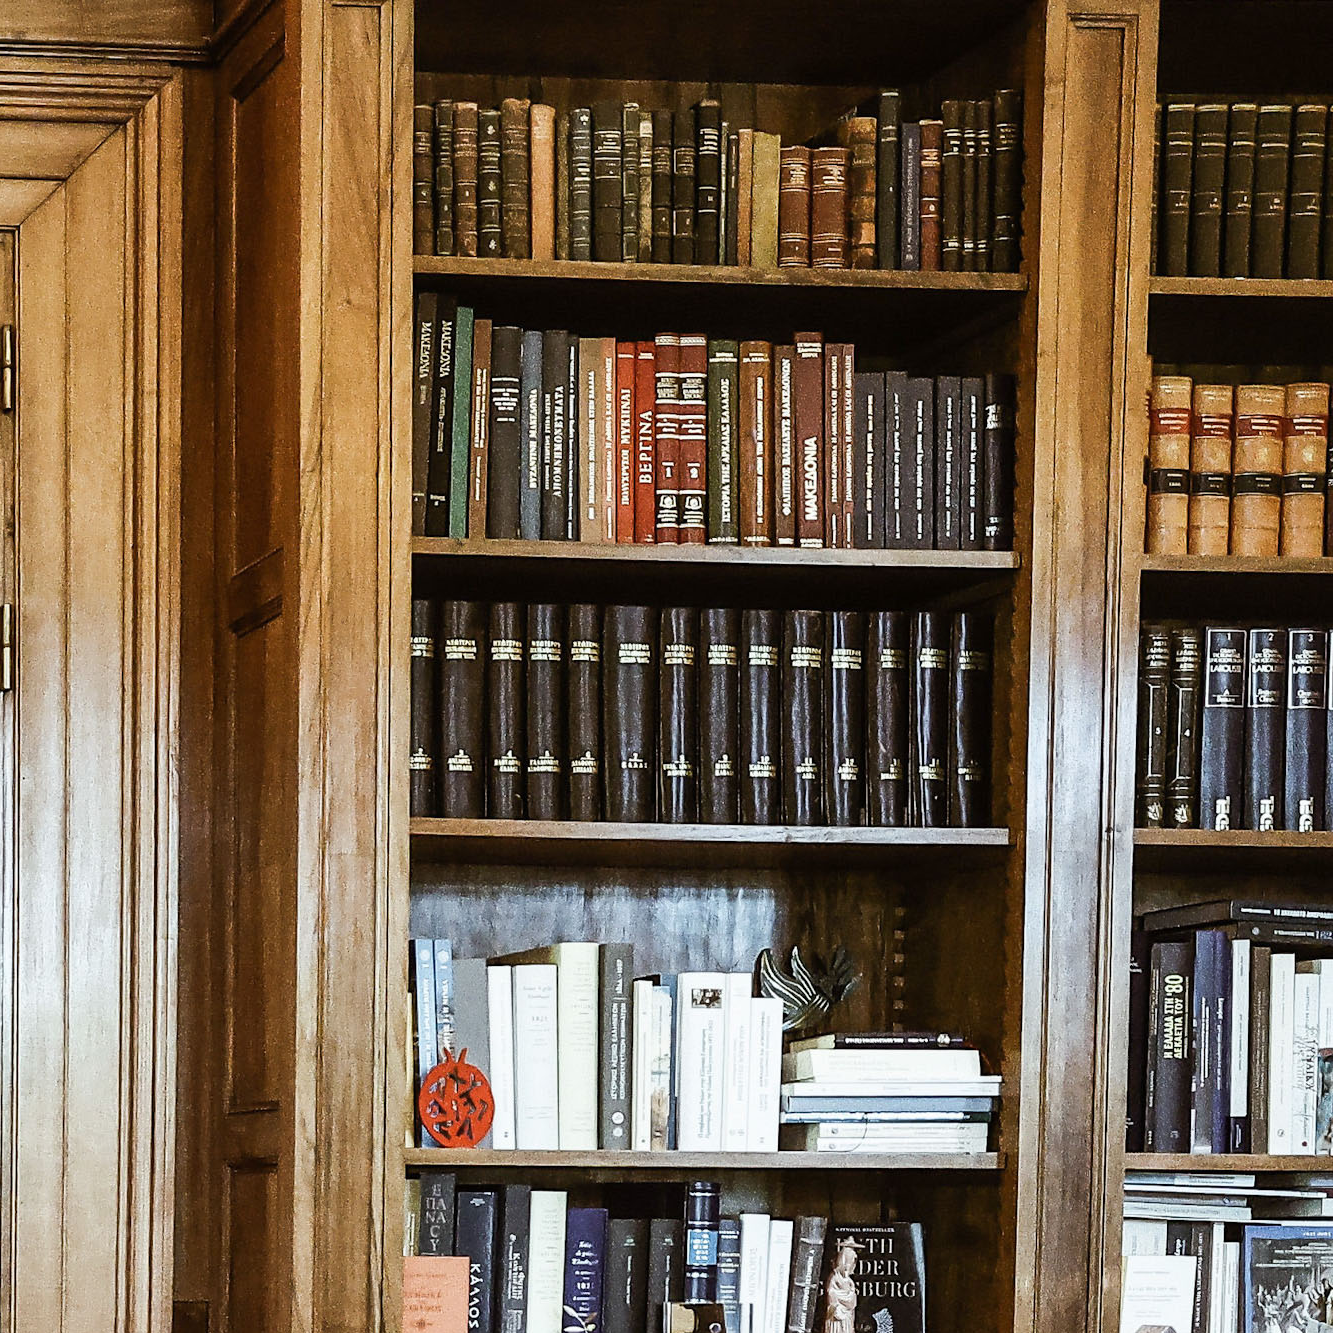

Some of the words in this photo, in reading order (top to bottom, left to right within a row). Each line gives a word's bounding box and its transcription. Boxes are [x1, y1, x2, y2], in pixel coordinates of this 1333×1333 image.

[619, 388, 632, 445] ΜΥΚΗΝΑΙ
[638, 410, 653, 484] ΒΕΡΓΙΝΑ
[804, 437, 818, 520] ΜΑΚΕΔΟΝΙΑ
[721, 484, 731, 523] ΙΣΤΟΡΙΑ
[1164, 997, 1174, 1015] ΣΤΗ
[1174, 998, 1183, 1015] ΤΟΥ
[1164, 1017, 1174, 1050] ΕΛΛΑΔΑ
[1174, 1016, 1183, 1059] ΔΕΚΑΕΤΙΑ
